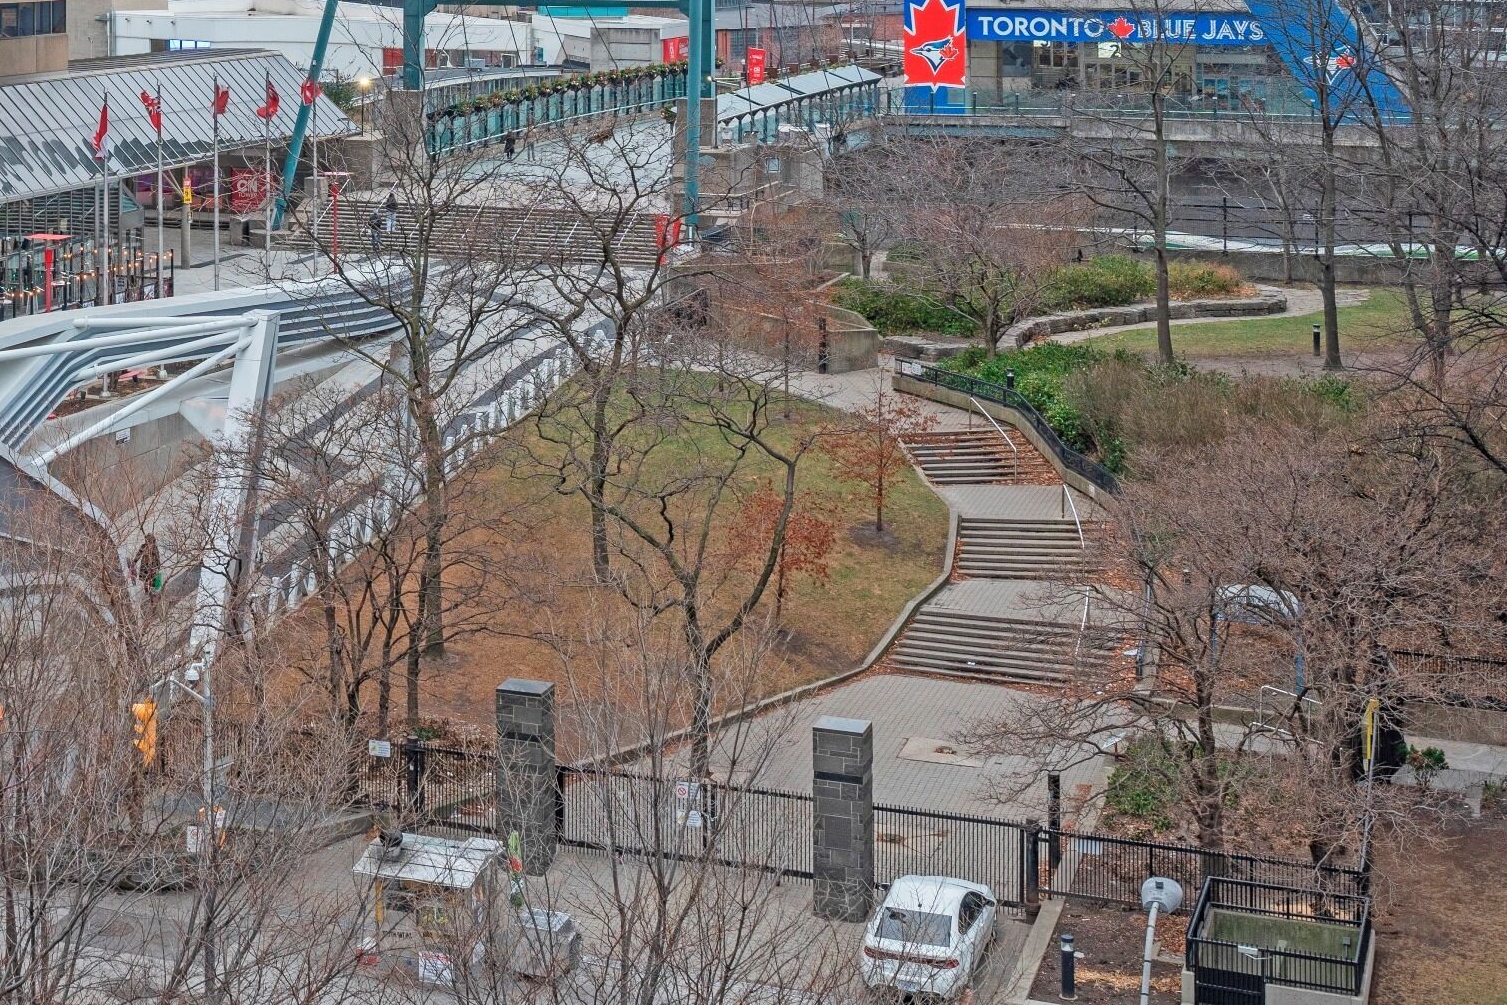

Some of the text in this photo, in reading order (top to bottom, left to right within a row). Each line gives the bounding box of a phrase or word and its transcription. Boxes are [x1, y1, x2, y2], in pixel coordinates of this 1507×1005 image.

[978, 16, 1263, 39] TORONTO BLUE JAYS
